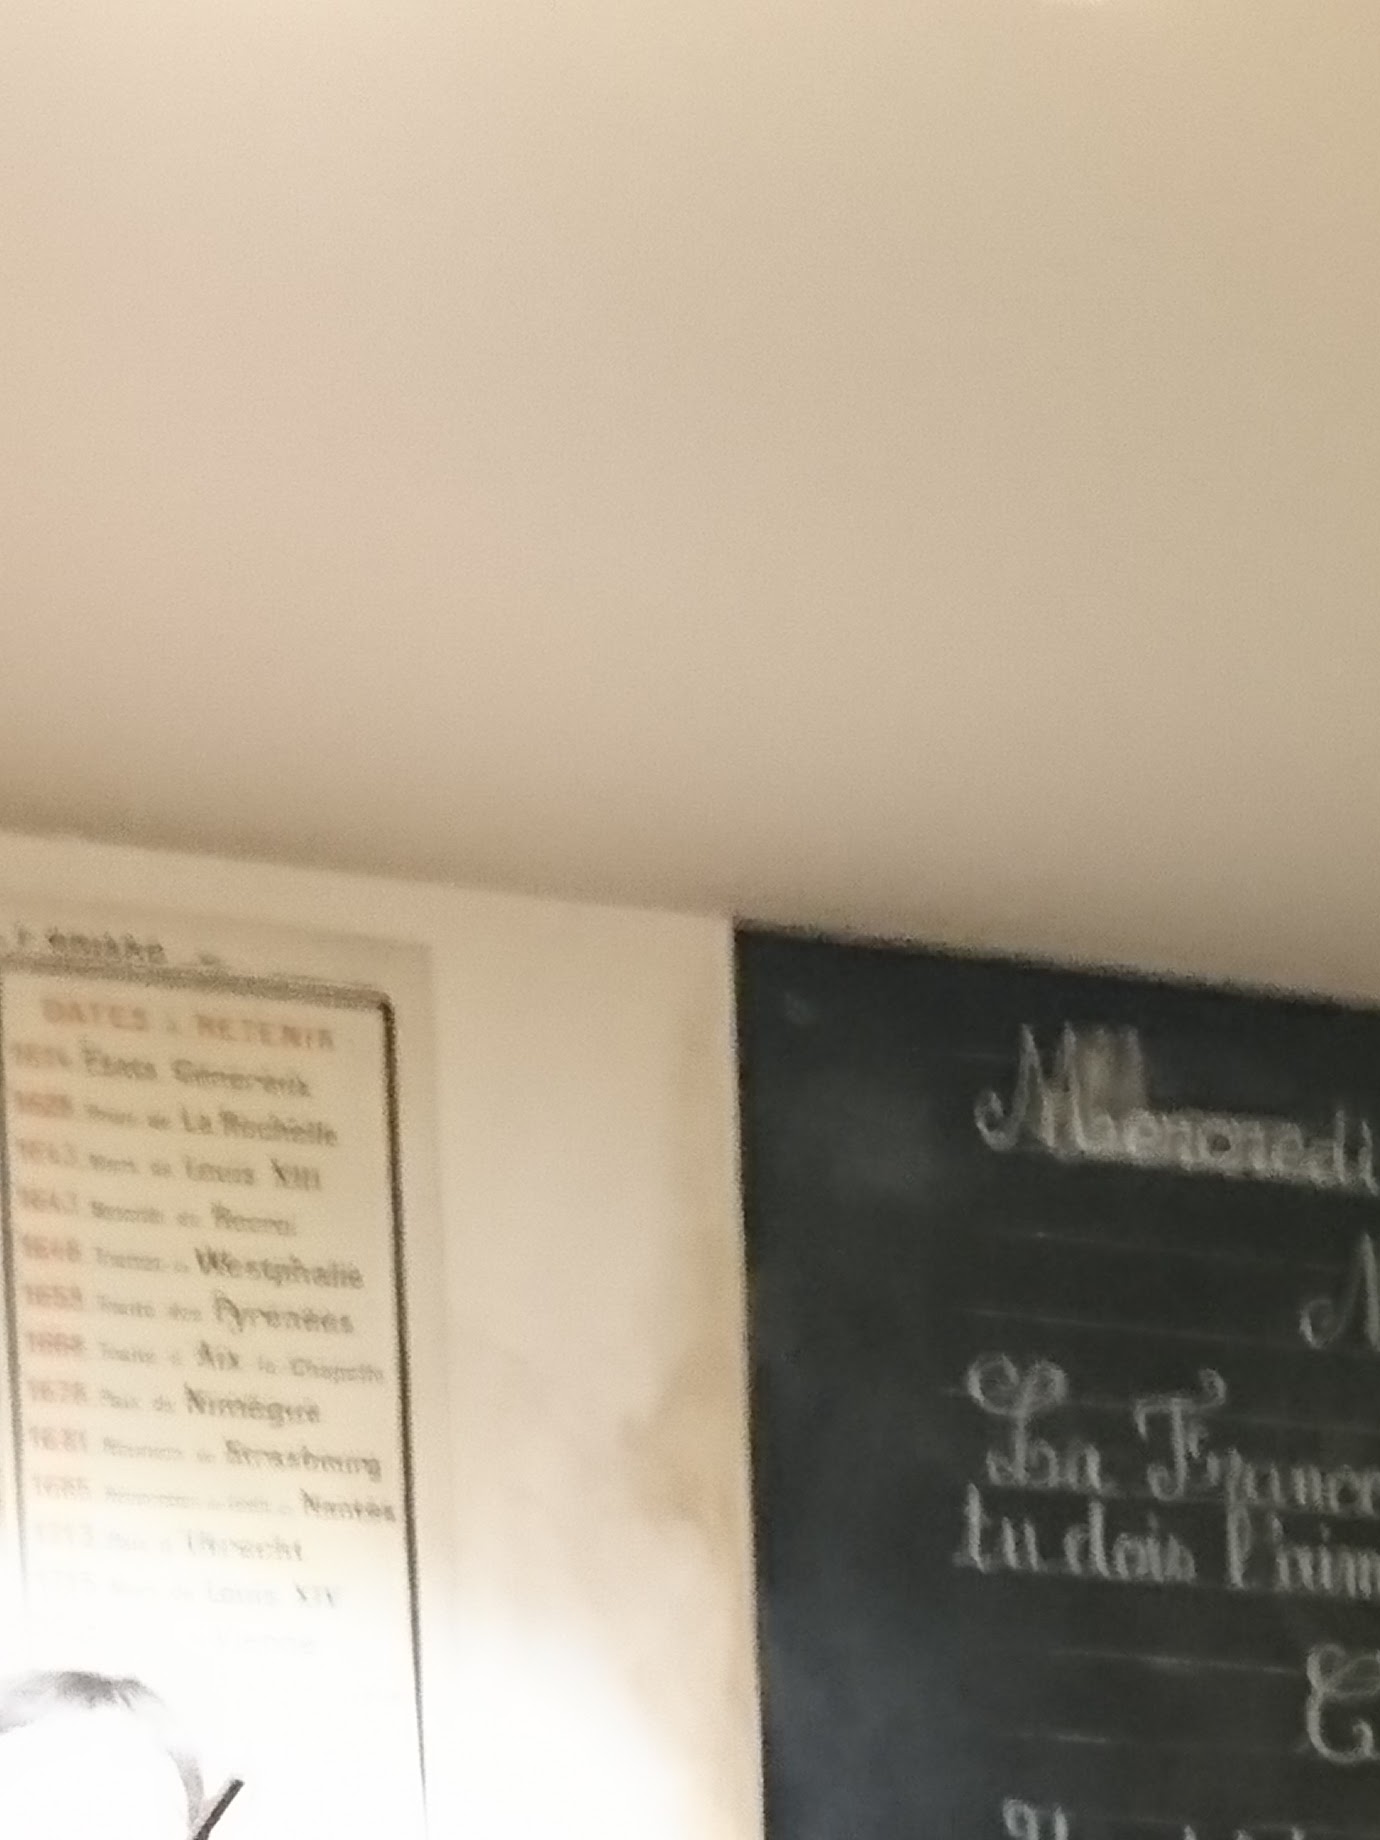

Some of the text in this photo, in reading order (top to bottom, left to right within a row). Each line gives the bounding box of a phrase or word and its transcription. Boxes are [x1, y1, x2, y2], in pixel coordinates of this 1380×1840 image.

[194, 1246, 364, 1290] Westphalie
[966, 1353, 1105, 1490] La
[1063, 1499, 1199, 1584] dois
